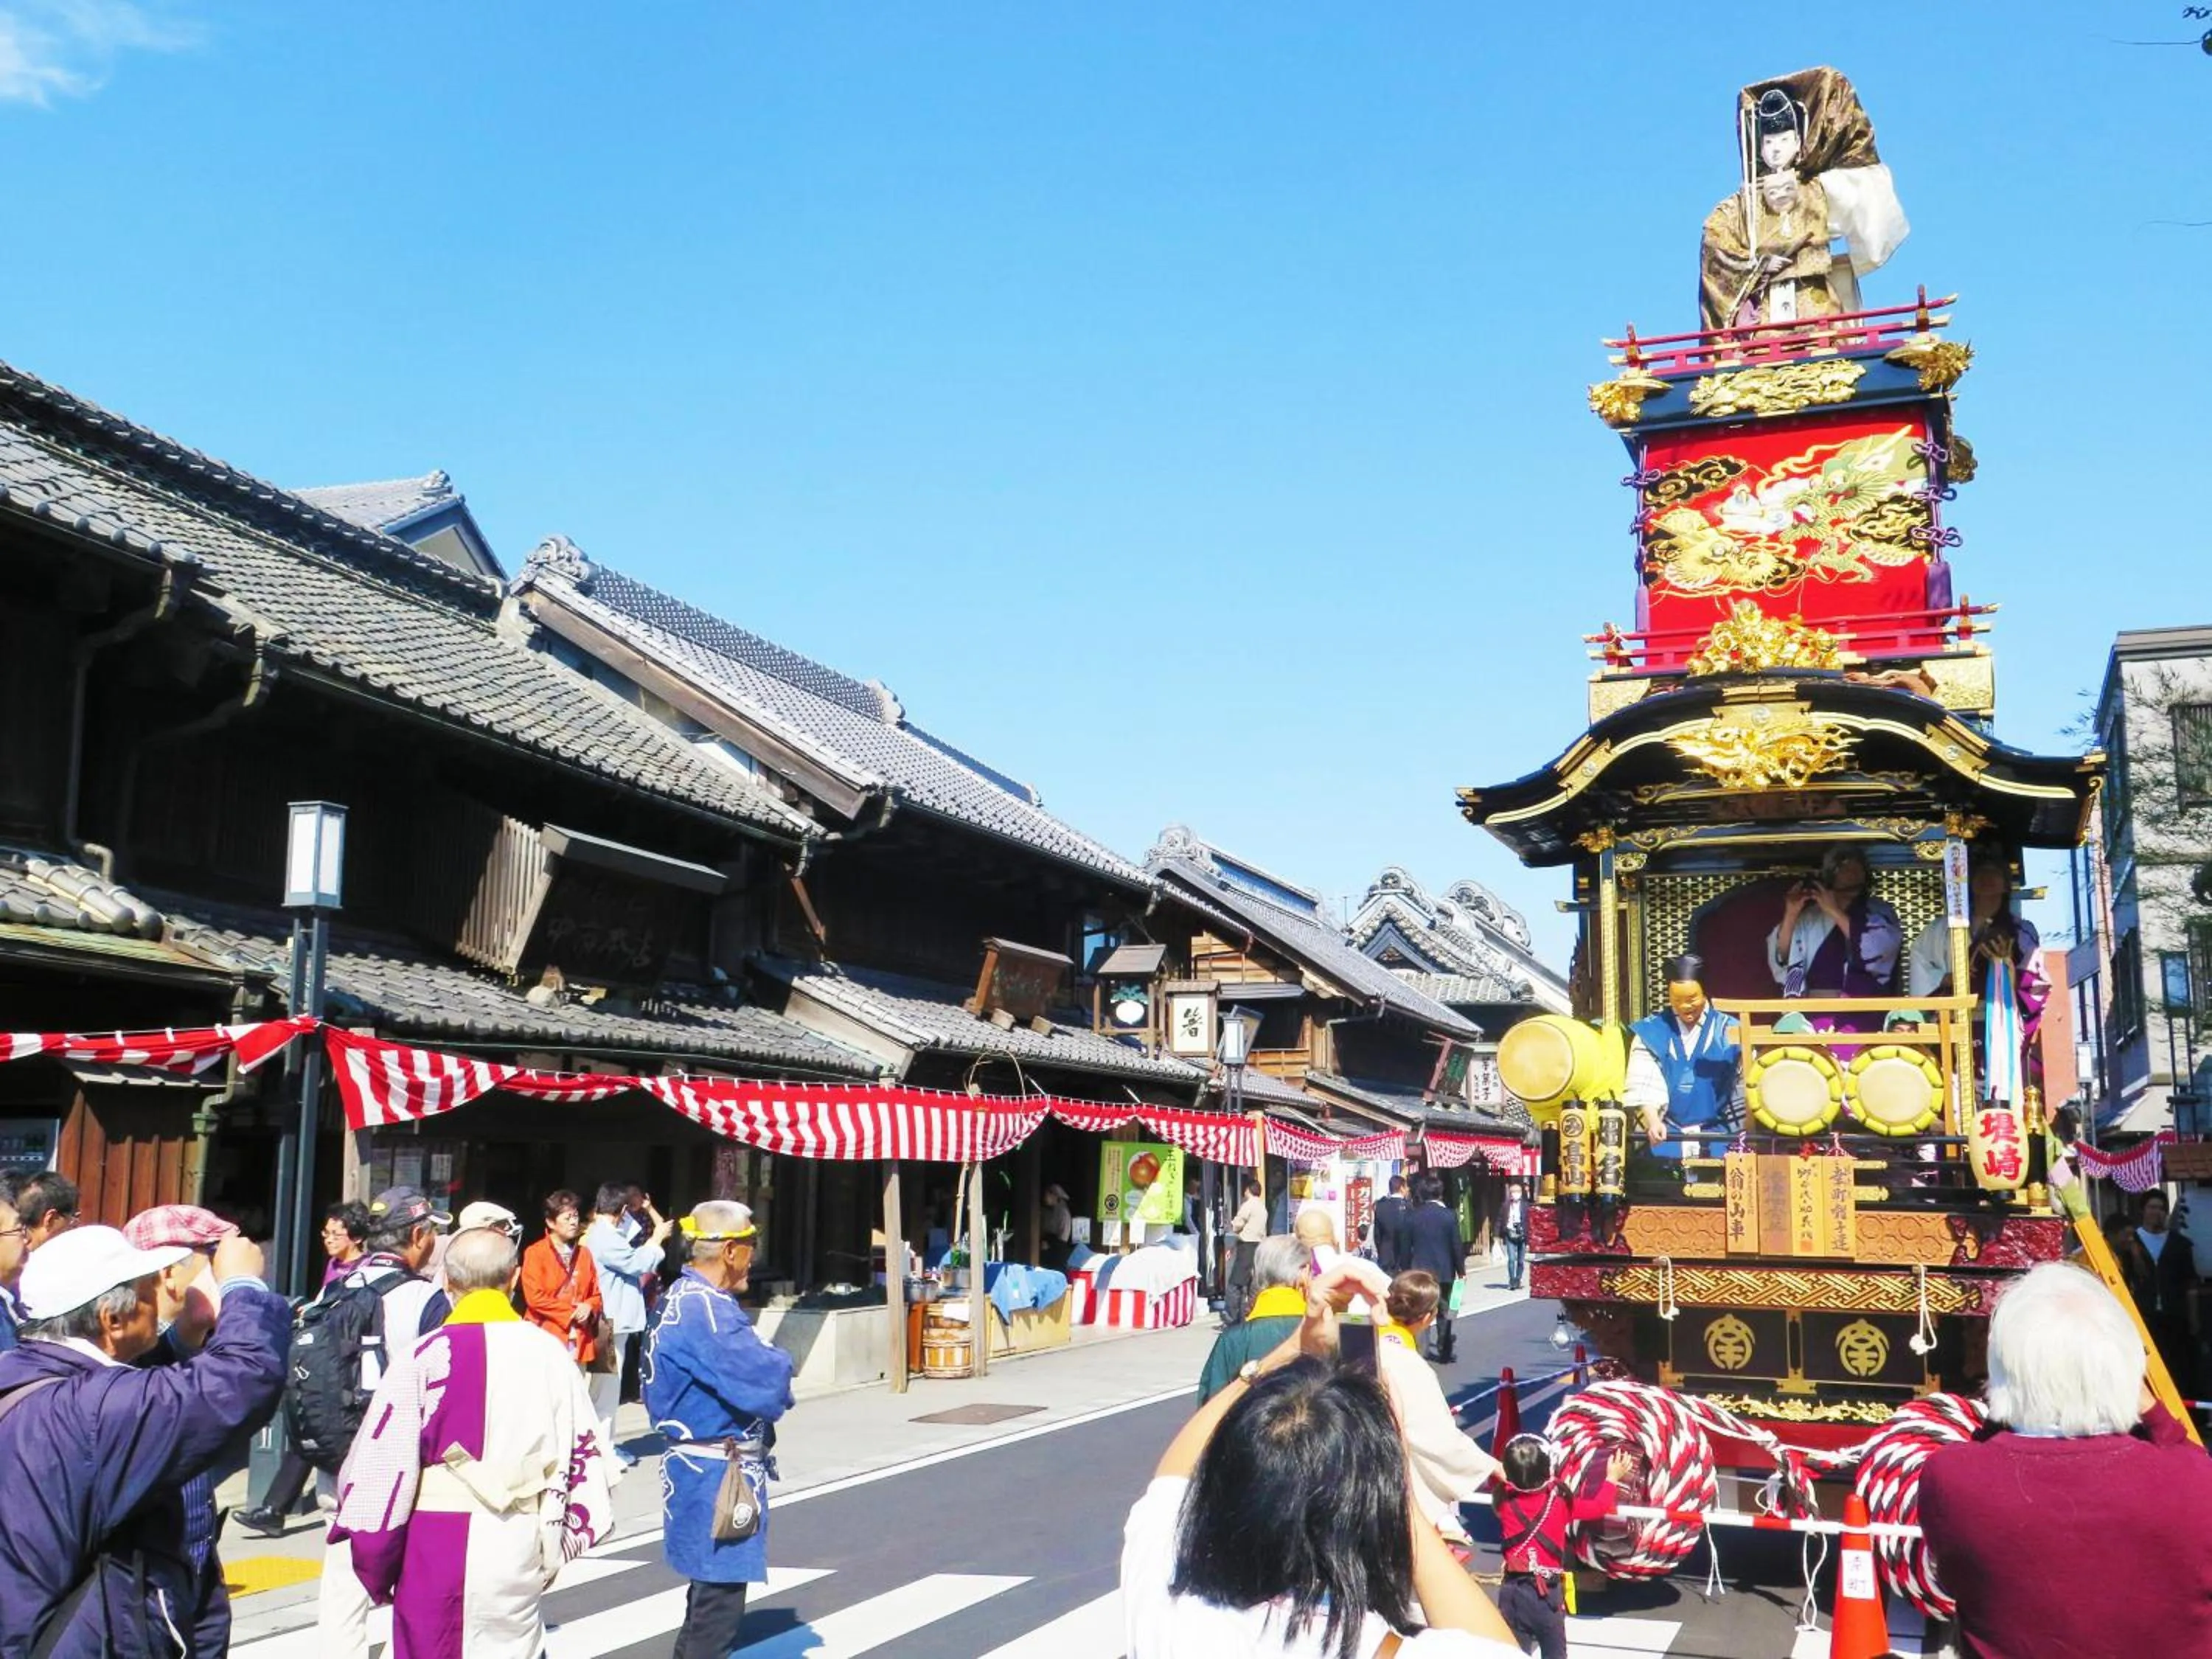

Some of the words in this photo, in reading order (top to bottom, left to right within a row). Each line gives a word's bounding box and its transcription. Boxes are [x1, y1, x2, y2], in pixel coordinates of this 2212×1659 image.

[1980, 1113, 2023, 1180] 堤崎
[1357, 1186, 1371, 1225] ガラス
[1729, 1167, 1745, 1243] 翁の山車
